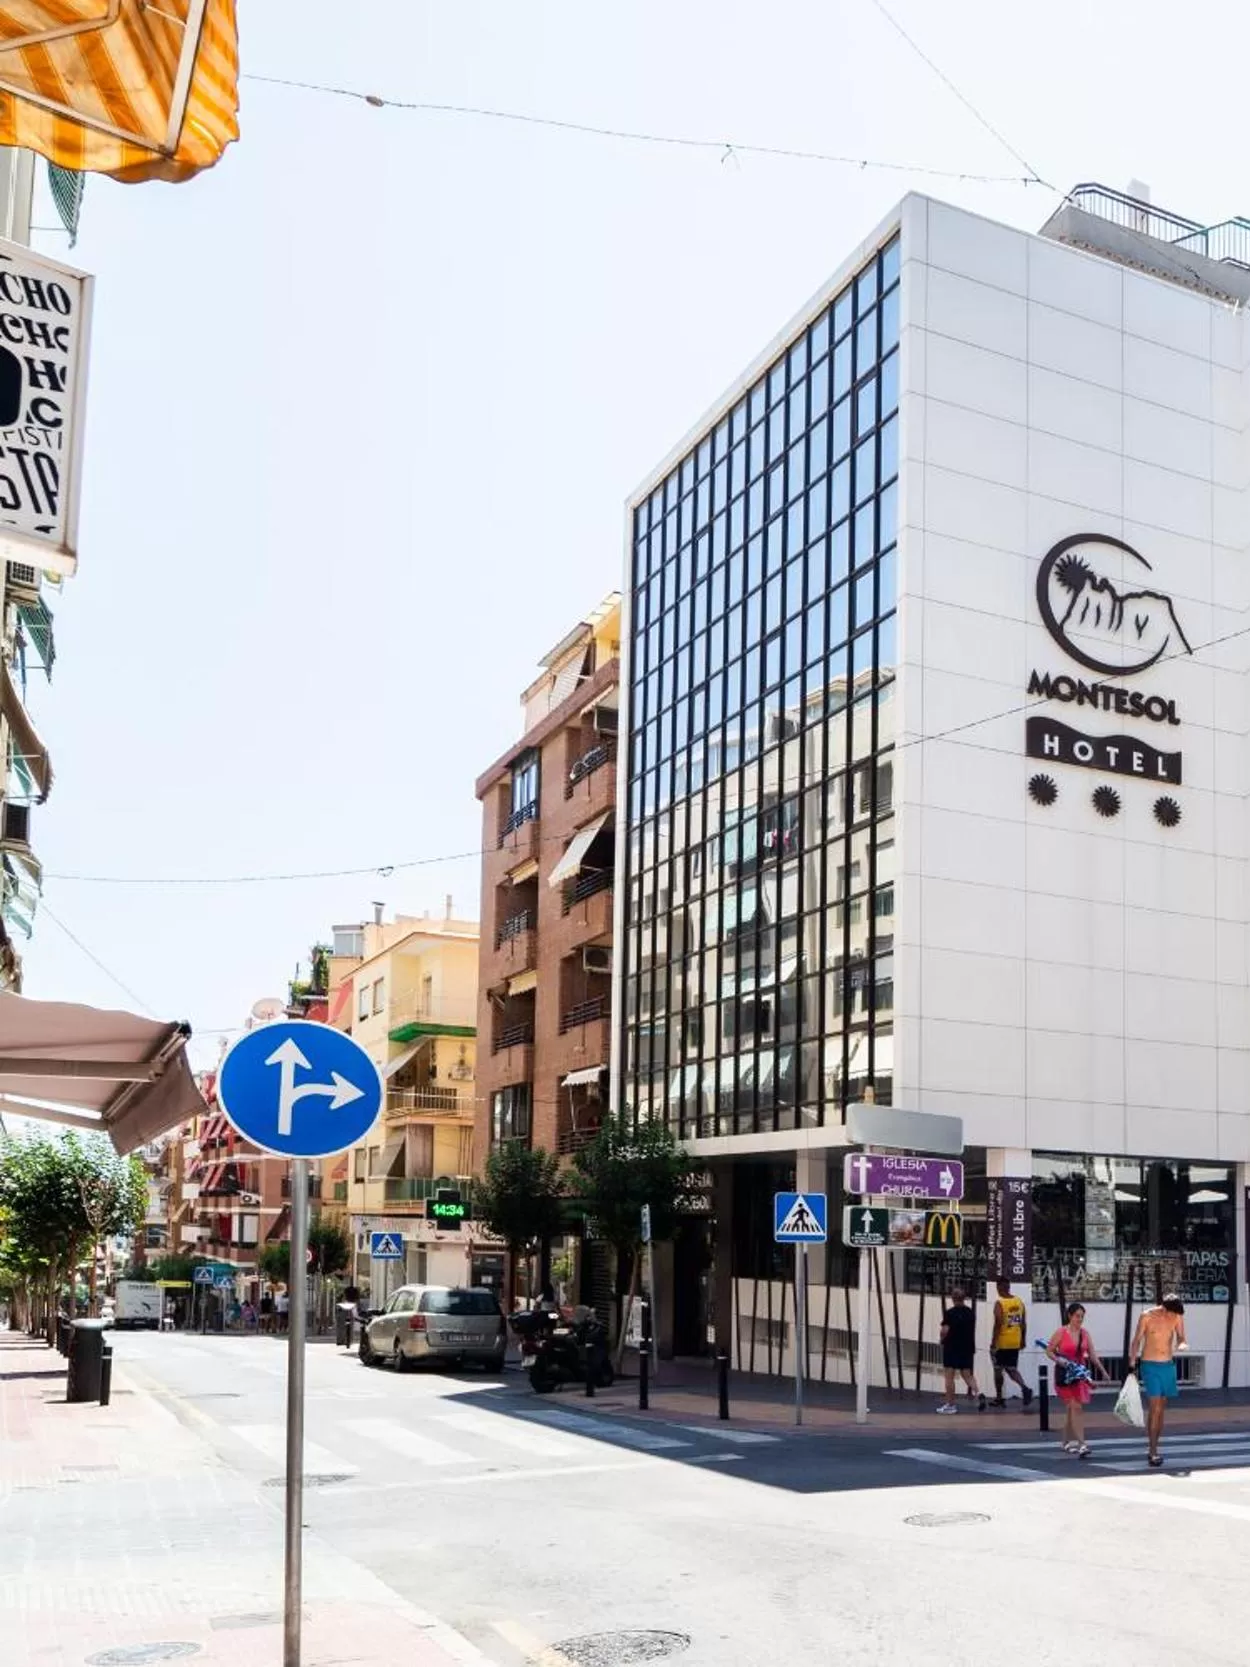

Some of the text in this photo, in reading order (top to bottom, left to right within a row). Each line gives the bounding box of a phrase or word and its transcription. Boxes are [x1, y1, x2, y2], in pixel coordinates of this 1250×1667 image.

[0, 271, 71, 315] CHO
[0, 313, 69, 353] CH
[1027, 668, 1181, 725] MONTESOL
[1044, 733, 1168, 777] HOTEL
[882, 1158, 928, 1171] IGLESIA
[881, 1184, 929, 1198] CHURCH
[1008, 1181, 1029, 1194] 15€
[433, 1203, 465, 1217] 14:34
[1184, 1251, 1229, 1267] TAPAS
